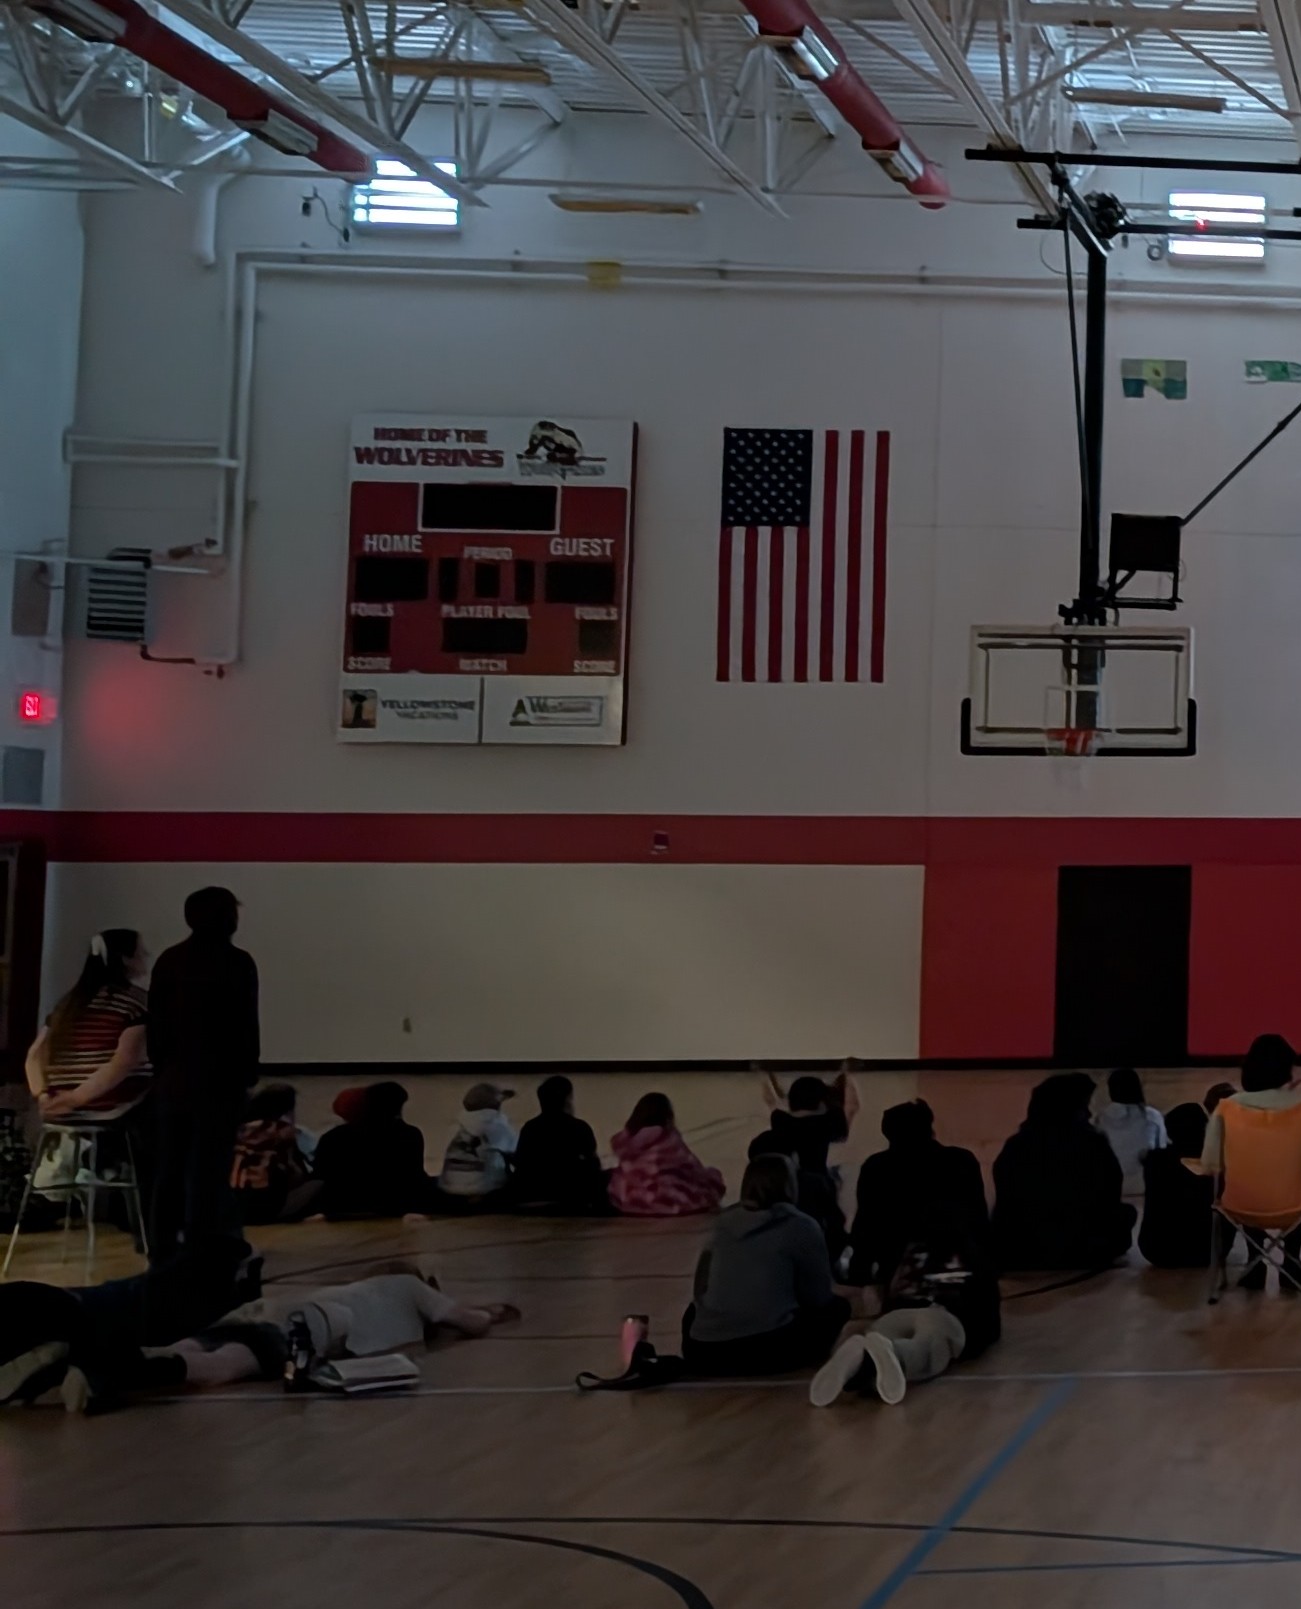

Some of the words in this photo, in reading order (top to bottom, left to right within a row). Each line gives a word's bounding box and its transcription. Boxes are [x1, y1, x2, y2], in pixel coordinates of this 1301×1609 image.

[374, 427, 426, 442] HOME
[428, 429, 451, 443] OF
[455, 429, 488, 444] THE
[353, 446, 504, 468] WOLVERINES
[363, 534, 423, 553] HOME
[549, 538, 615, 557] GUEST
[463, 546, 513, 560] PERIOD
[350, 603, 395, 618] FOULS
[440, 604, 493, 619] PLAYER
[498, 605, 532, 619] FOUL
[574, 606, 619, 620] FOULS
[347, 656, 392, 671] SCORE
[573, 659, 617, 673] SCORE
[380, 699, 475, 710] YELLOWSTONE
